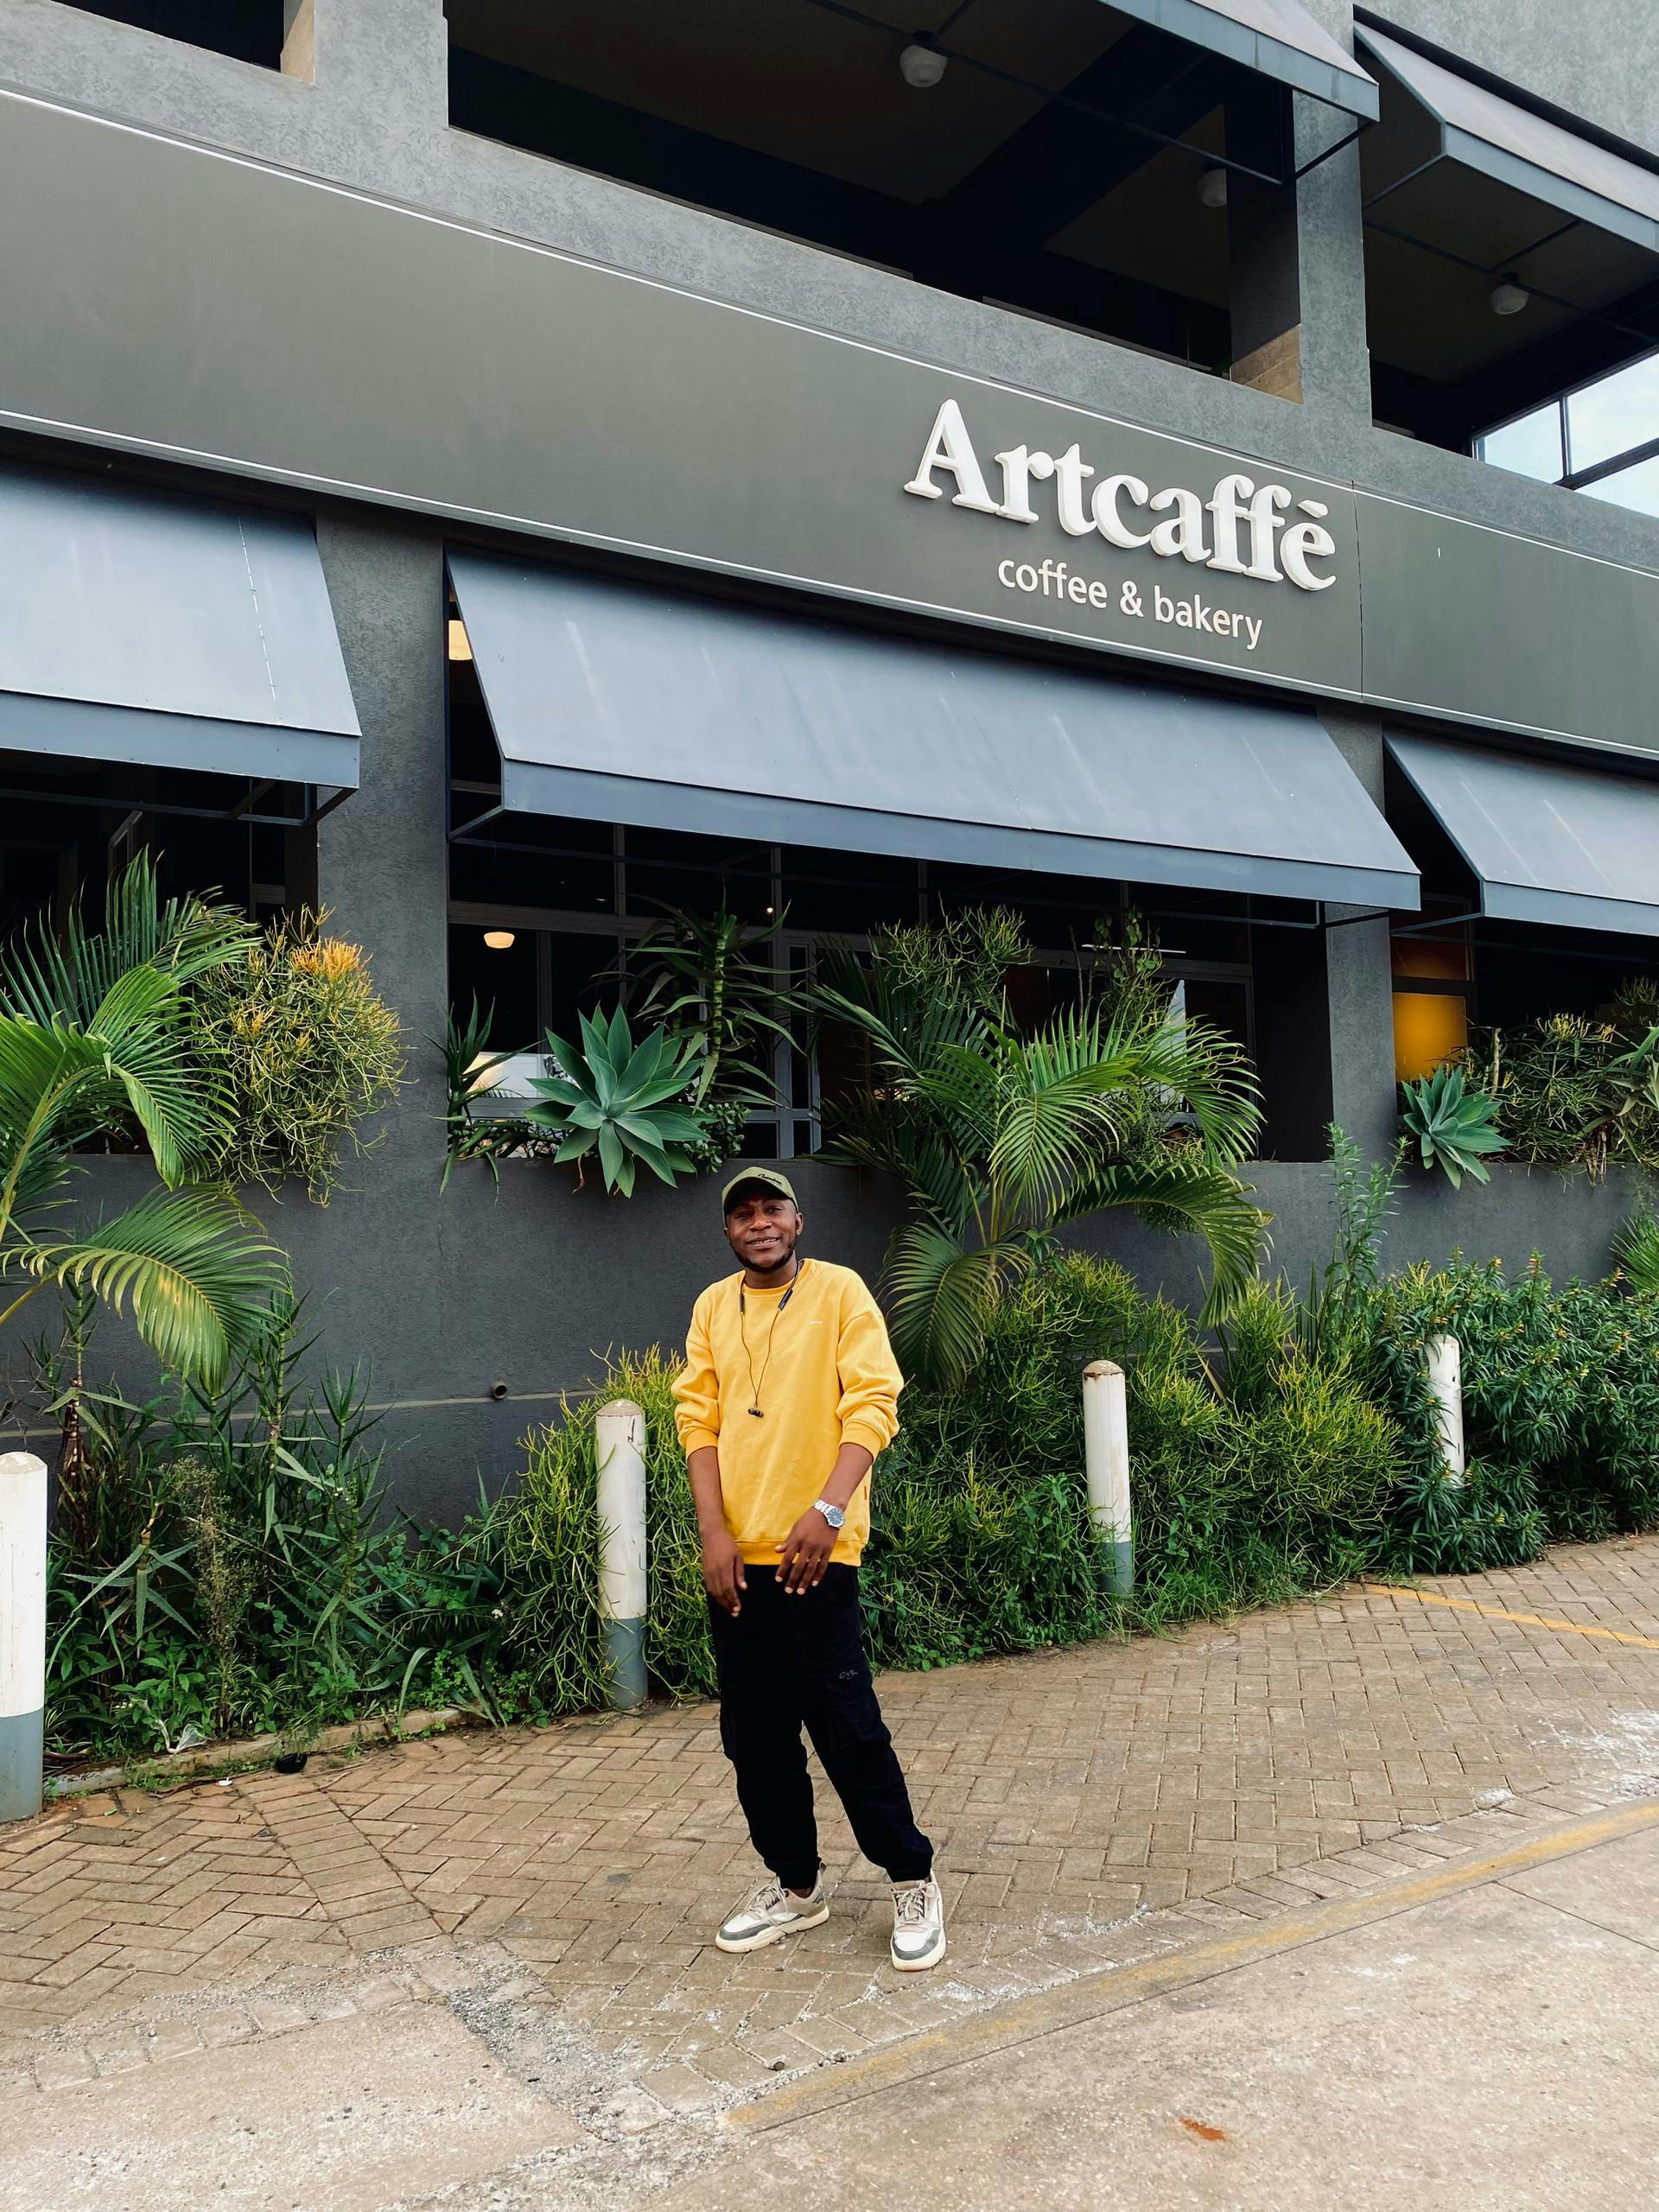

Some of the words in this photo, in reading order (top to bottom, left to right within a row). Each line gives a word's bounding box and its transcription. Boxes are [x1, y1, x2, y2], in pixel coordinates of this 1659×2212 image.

[998, 558, 1108, 608] coffee
[1120, 580, 1144, 618] &
[1154, 585, 1263, 651] bakery
